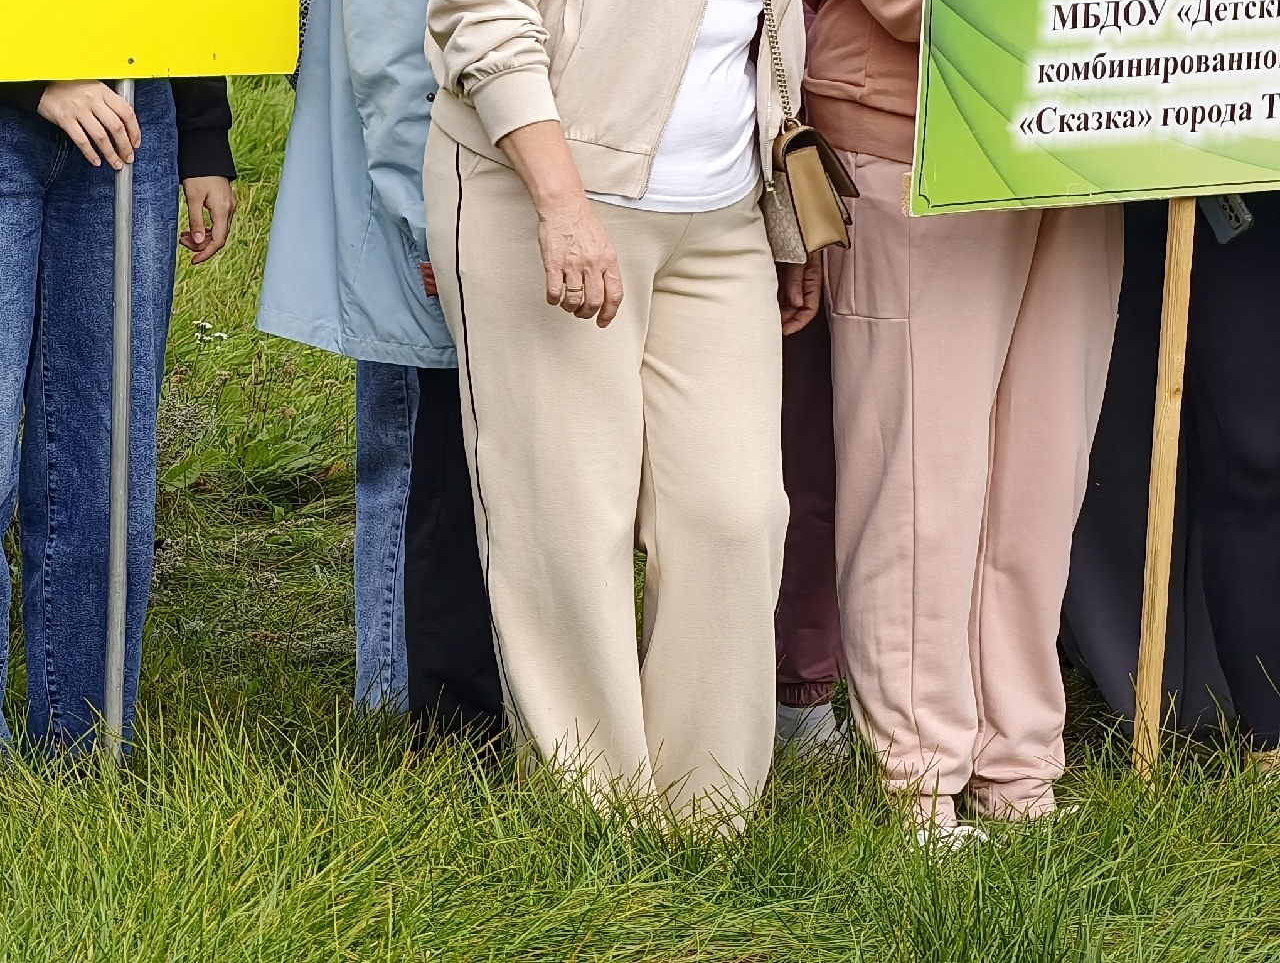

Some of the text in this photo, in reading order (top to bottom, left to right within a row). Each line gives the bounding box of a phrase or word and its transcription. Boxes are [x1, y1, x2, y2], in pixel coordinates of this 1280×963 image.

[1037, 49, 1280, 84] комбинированно
[1019, 106, 1153, 136] «Сказка»
[1161, 101, 1253, 133] города
